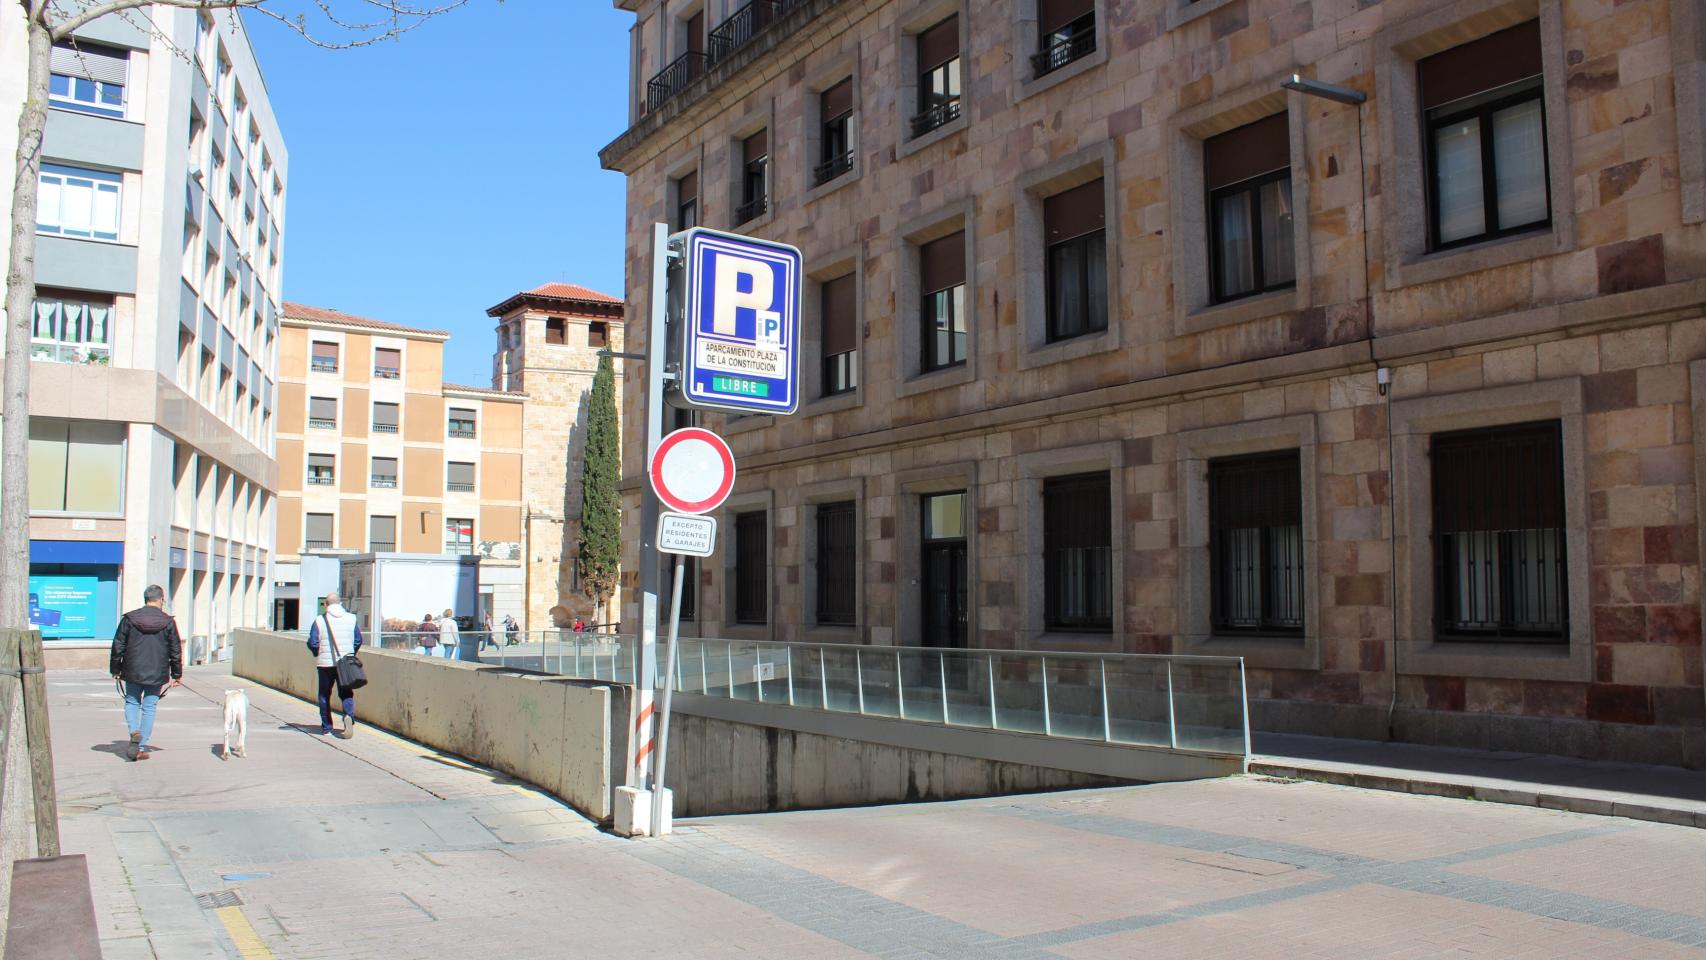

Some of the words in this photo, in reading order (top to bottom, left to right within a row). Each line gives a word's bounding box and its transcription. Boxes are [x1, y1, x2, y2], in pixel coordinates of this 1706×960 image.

[713, 253, 774, 336] P
[706, 343, 755, 359] APARCAMIENTO
[757, 351, 778, 361] PLAZA
[707, 354, 716, 364] DE
[718, 356, 726, 365] LA
[729, 357, 776, 372] CONSTITUCION
[721, 378, 757, 393] LIBRE
[672, 521, 703, 530] EXCEPTO
[665, 529, 708, 540] RESIDENTES
[674, 540, 706, 548] GARAJES
